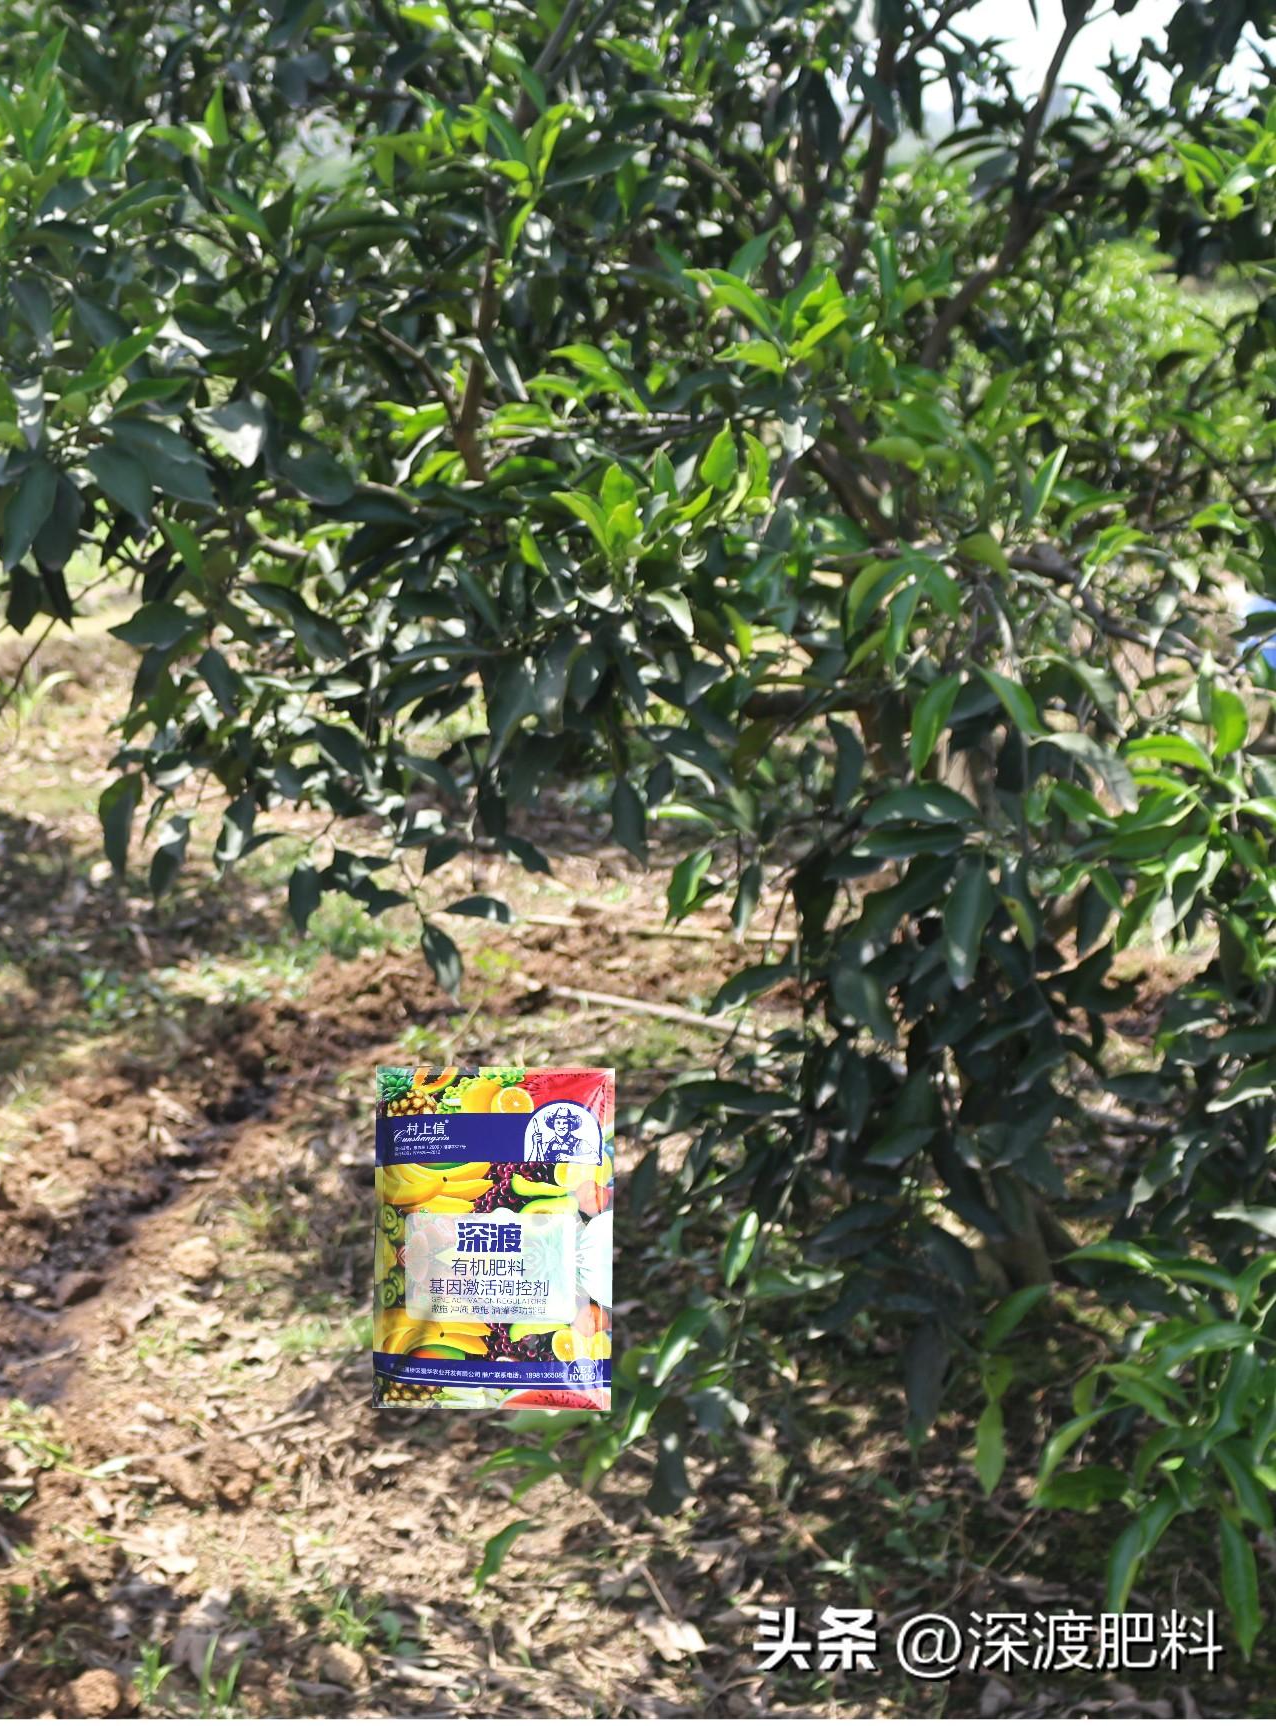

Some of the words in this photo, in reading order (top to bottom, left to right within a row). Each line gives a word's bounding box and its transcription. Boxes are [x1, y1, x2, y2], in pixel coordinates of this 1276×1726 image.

[406, 1121, 446, 1135] 村上信
[456, 1222, 522, 1253] 深渡
[451, 1257, 527, 1277] 有机肥料
[429, 1278, 550, 1297] 基因激活调控剂
[569, 1372, 596, 1381] 1000G
[573, 1365, 592, 1374] NET
